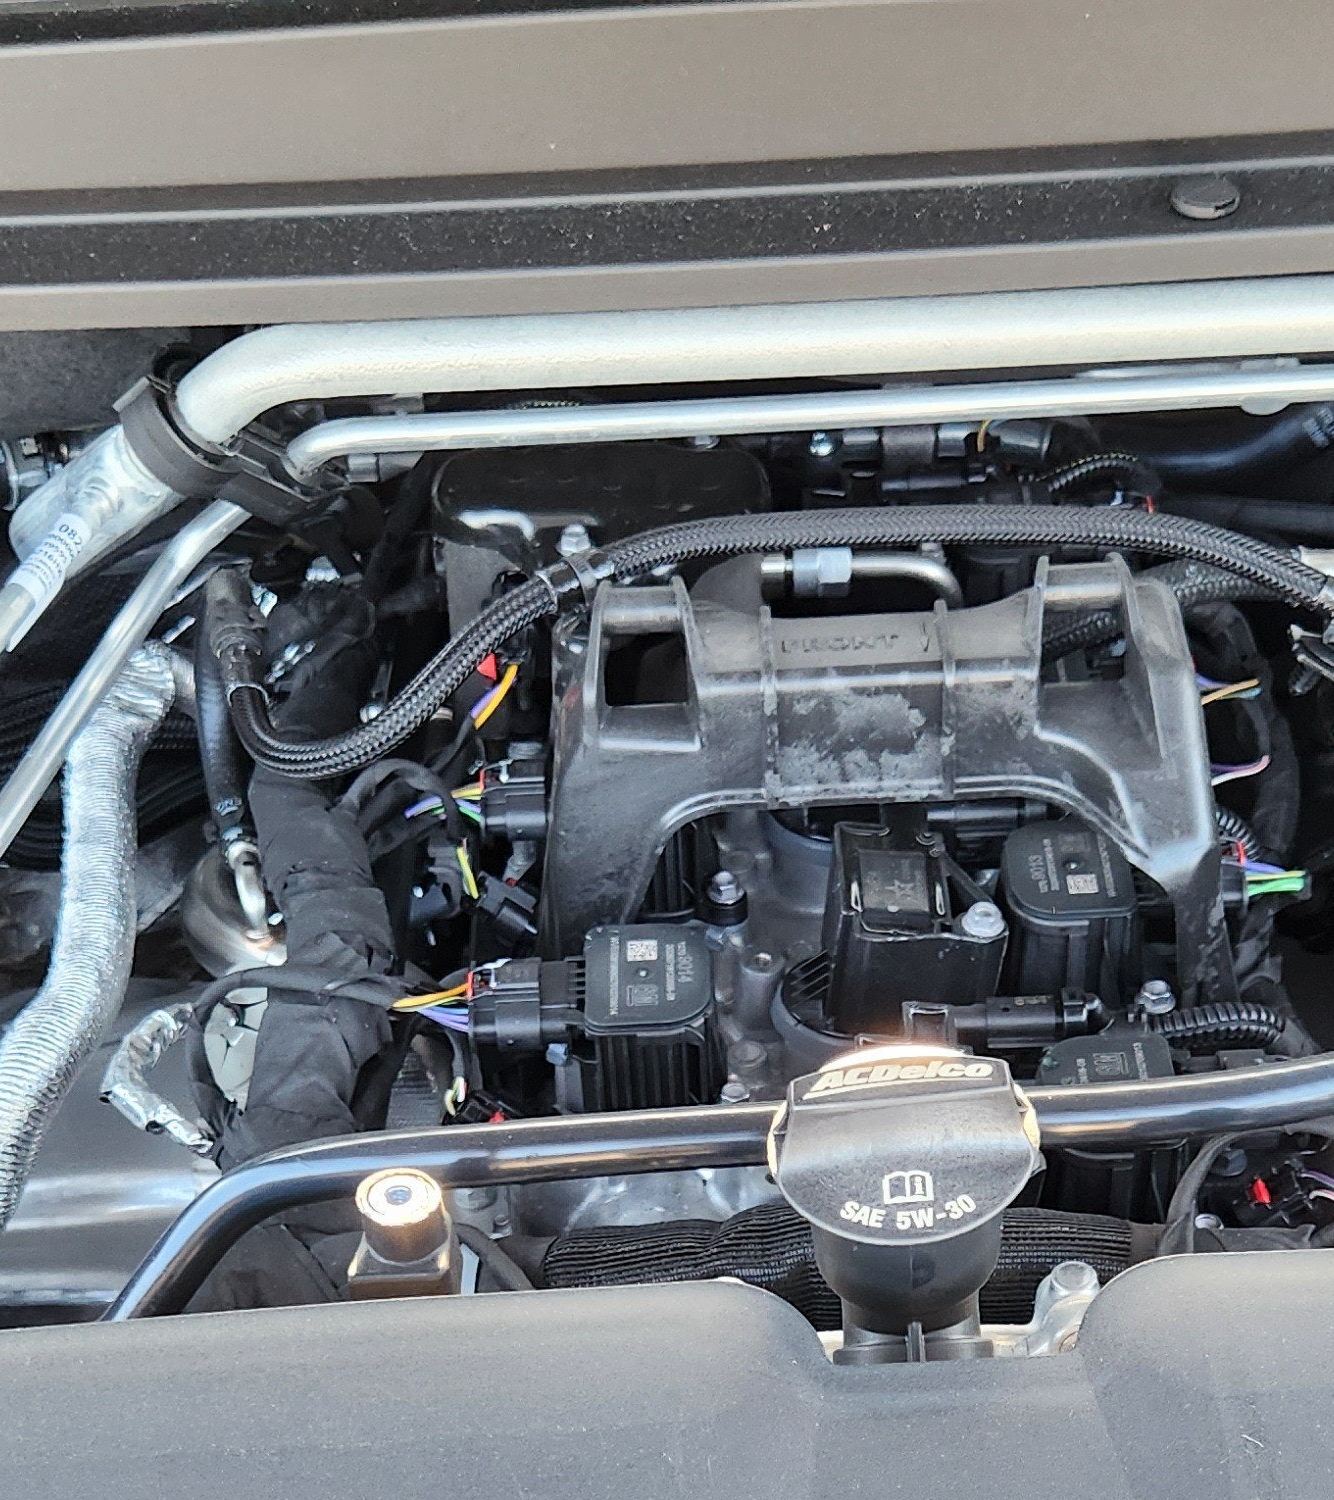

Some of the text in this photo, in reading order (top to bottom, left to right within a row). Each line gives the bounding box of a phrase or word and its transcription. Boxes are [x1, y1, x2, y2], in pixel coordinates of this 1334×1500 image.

[809, 1060, 994, 1093] ACDelco
[839, 1194, 977, 1230] SAE 5W-30
